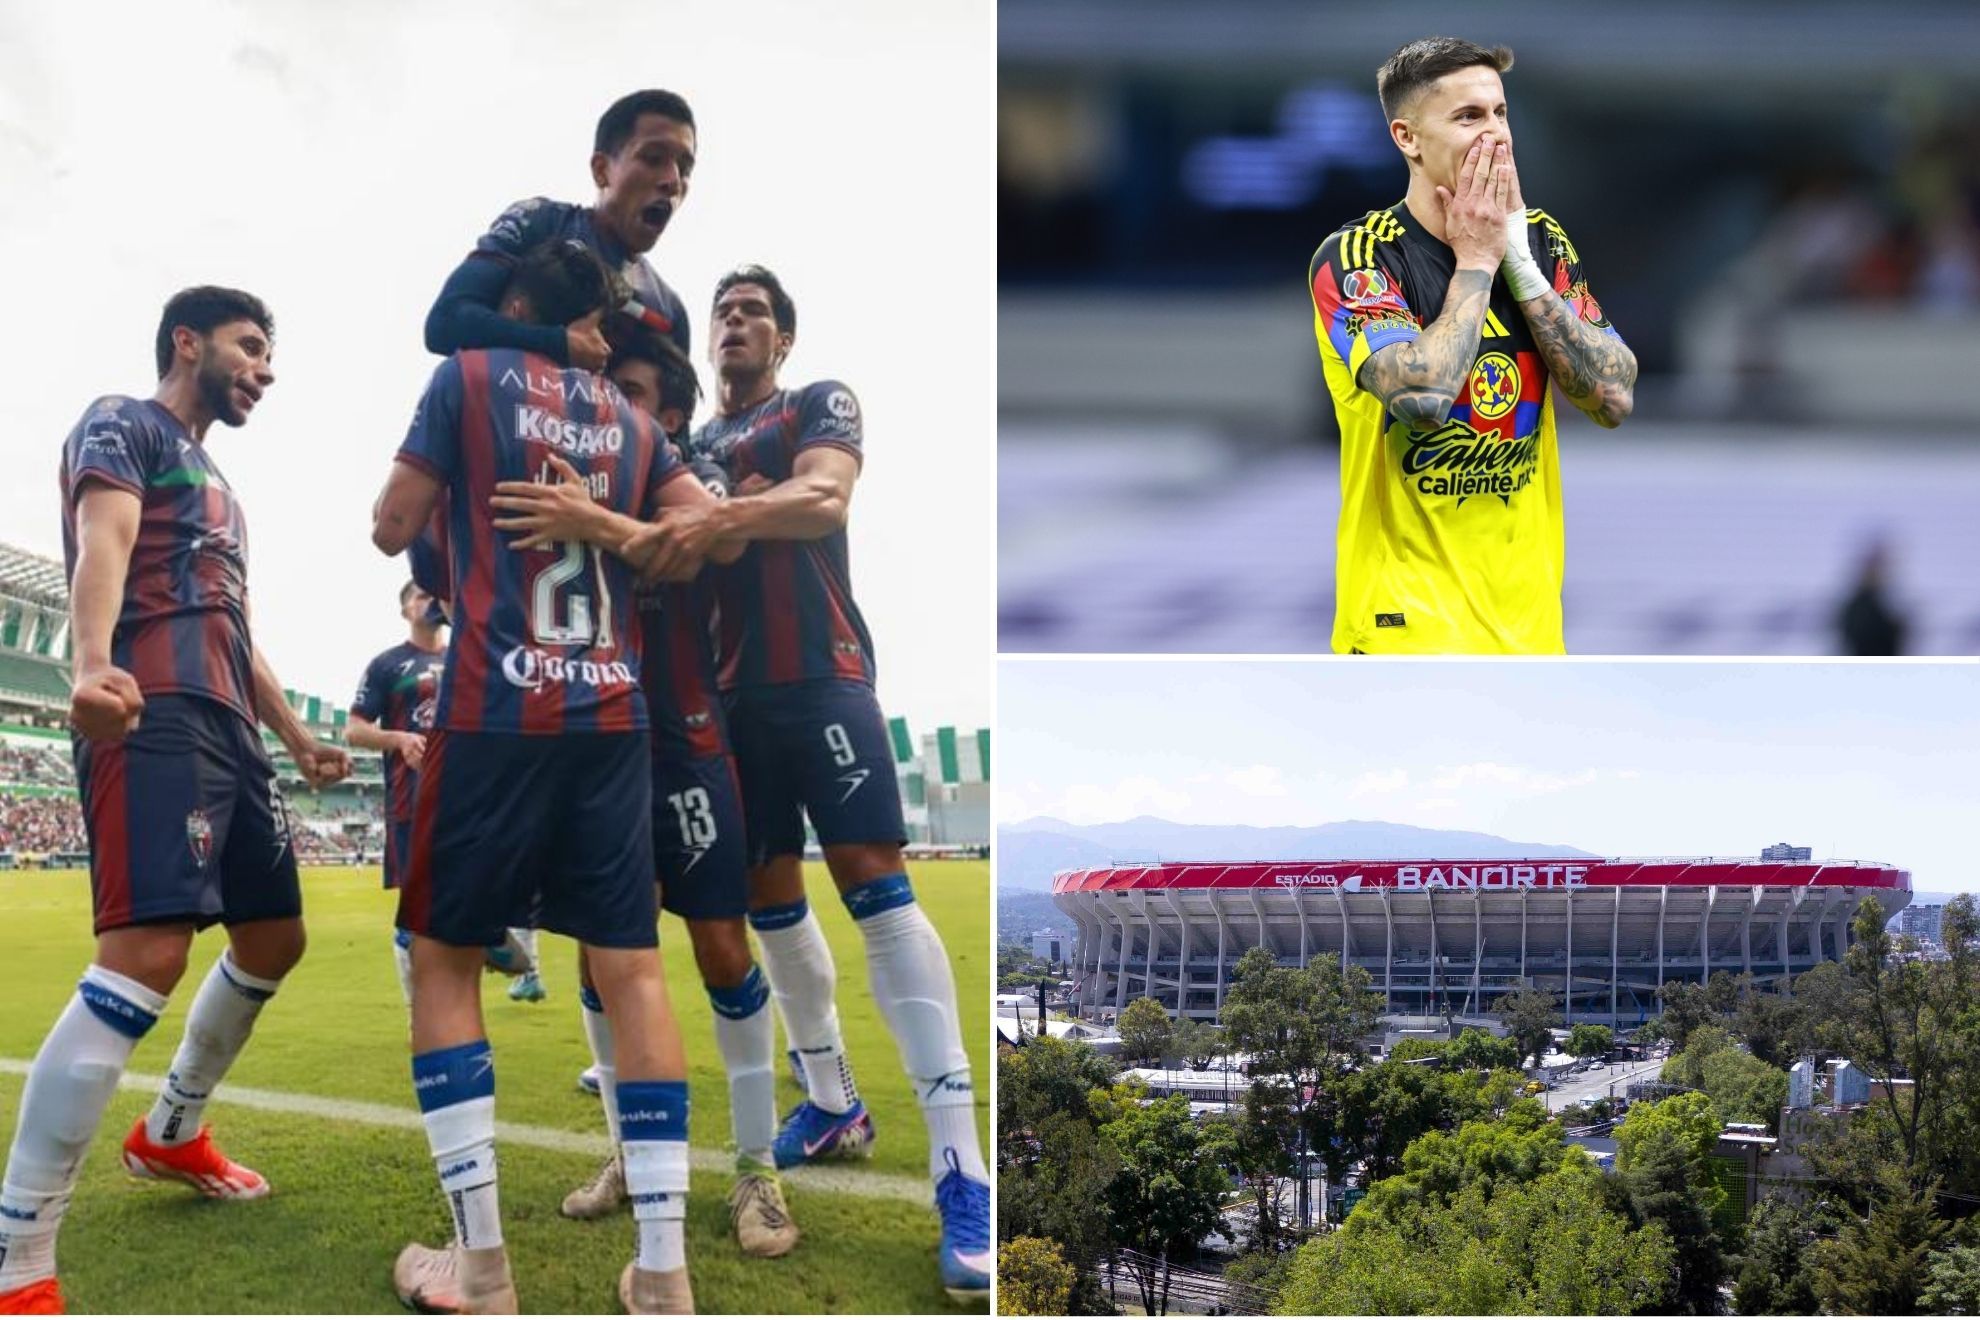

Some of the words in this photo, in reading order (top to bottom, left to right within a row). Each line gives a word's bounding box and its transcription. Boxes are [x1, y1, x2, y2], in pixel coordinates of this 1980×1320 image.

[516, 405, 623, 456] KOSAKO
[502, 646, 637, 693] Corona
[824, 723, 856, 767] 9
[667, 786, 717, 847] 13
[1275, 874, 1336, 885] ESTADIO
[1398, 866, 1588, 890] BANORTE
